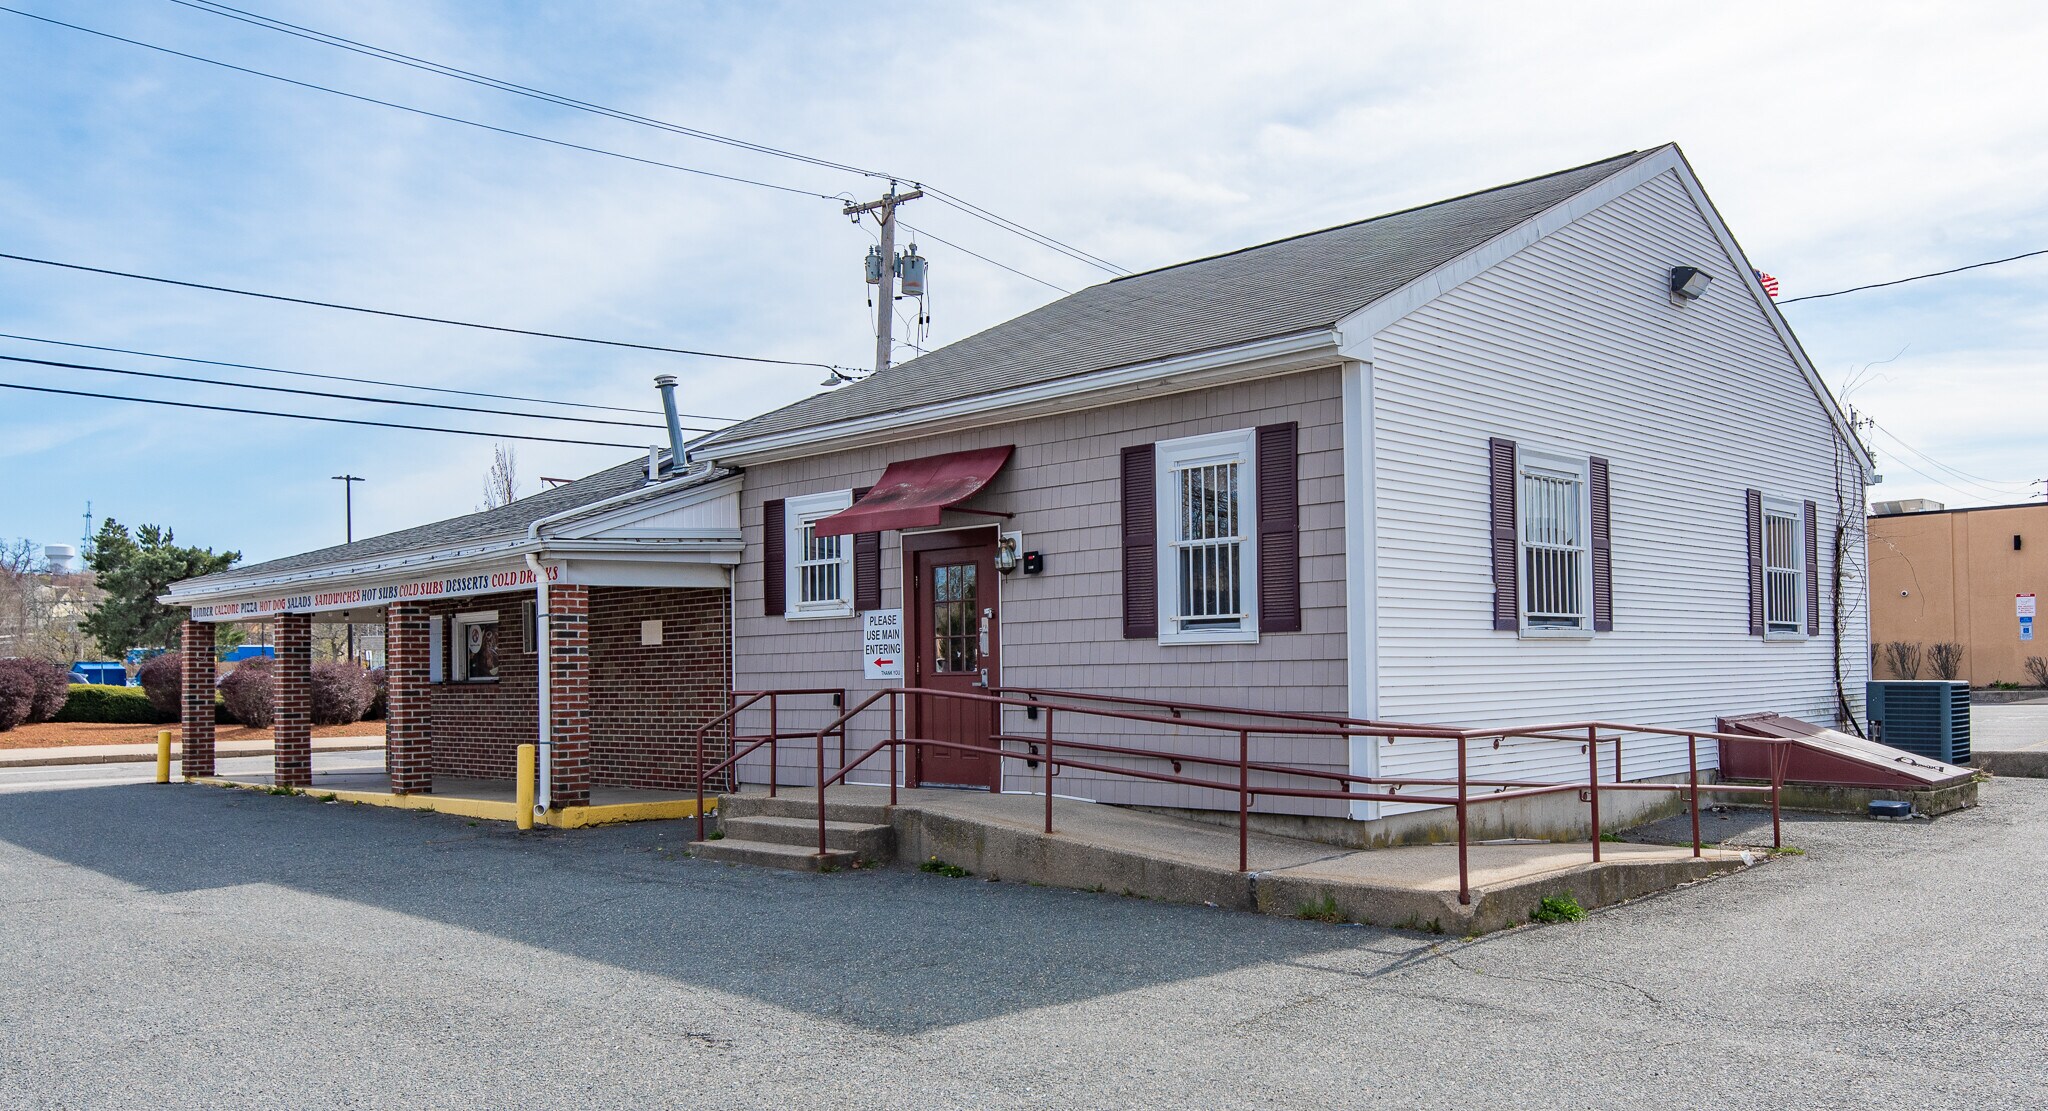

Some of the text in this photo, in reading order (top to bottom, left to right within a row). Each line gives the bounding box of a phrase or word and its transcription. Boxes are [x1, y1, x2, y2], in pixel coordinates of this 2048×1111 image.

[193, 566, 558, 617] DINNER CALZONE PIZZA HOT DOG SALADS SANDWICHES HOT SUBS COLD SUBS DESSERTS COLD DRIKS
[869, 615, 897, 626] PLEASE
[866, 629, 900, 641] USE MAIN
[865, 643, 901, 655] ENTERING
